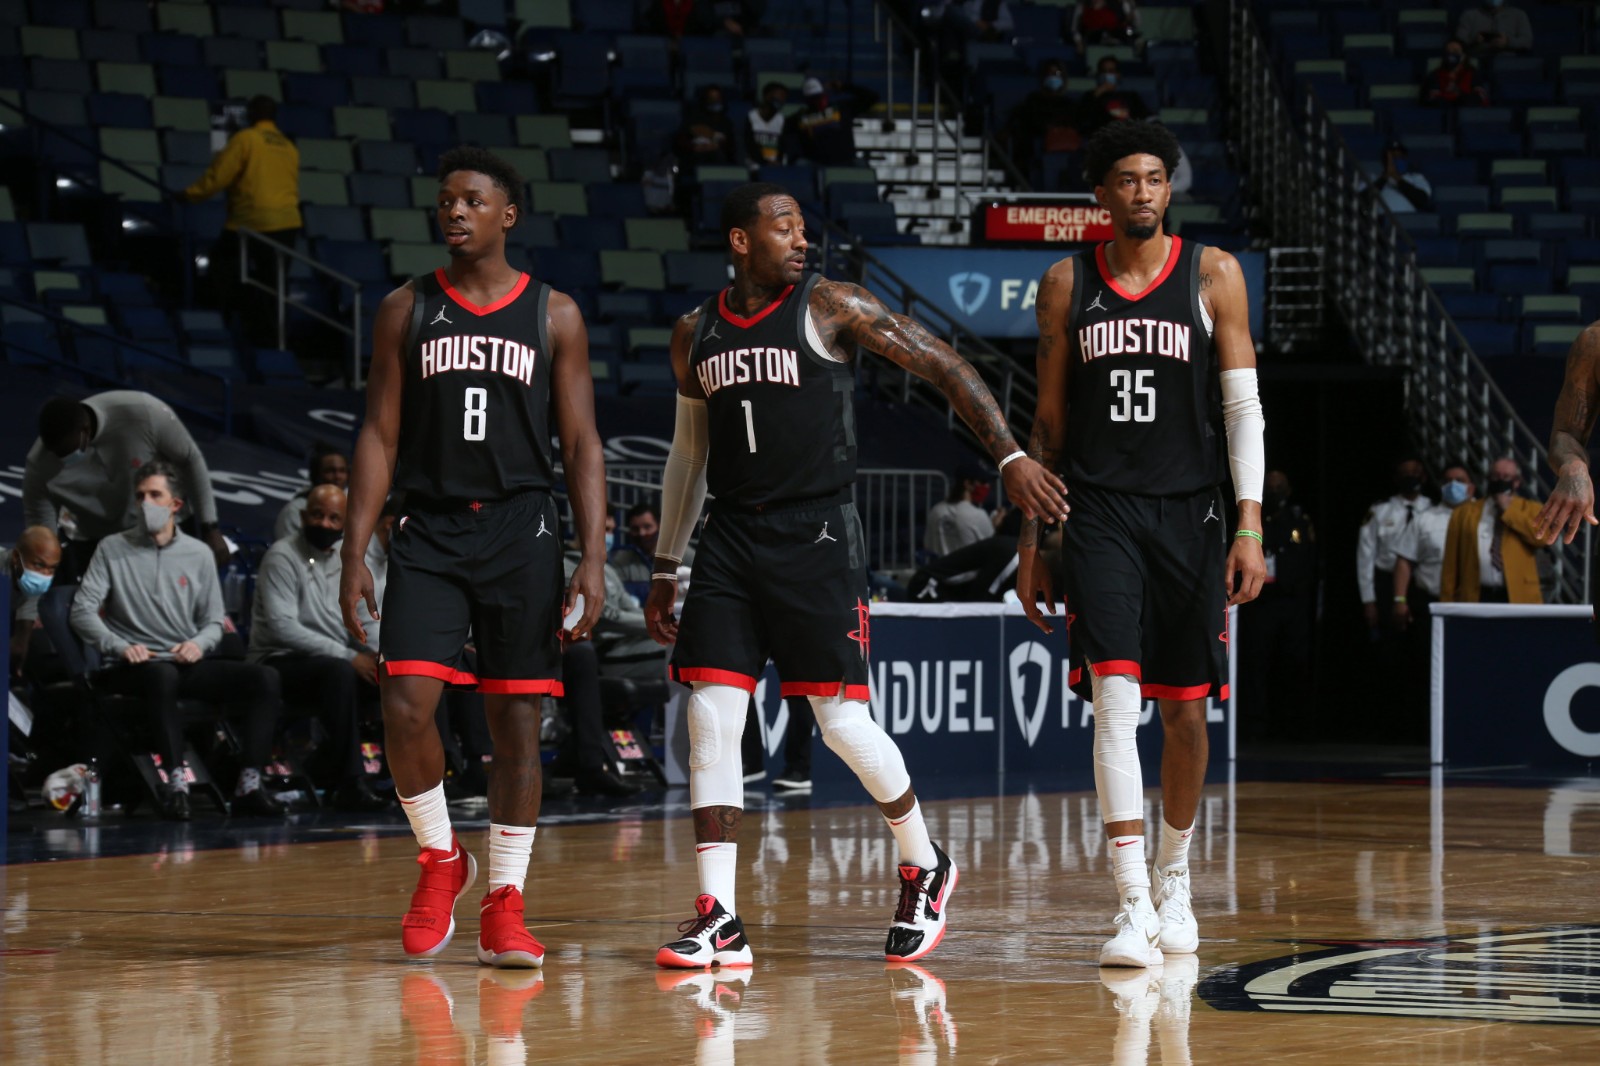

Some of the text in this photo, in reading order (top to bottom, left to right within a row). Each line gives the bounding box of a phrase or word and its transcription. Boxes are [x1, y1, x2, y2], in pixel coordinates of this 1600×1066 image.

[1006, 206, 1113, 225] EMERGENC
[1044, 224, 1086, 242] EXIT
[421, 335, 536, 387] HOUSTON
[1079, 318, 1190, 363] HOUSTON
[696, 347, 800, 399] HOUSTON
[1110, 369, 1156, 422] 35
[463, 387, 488, 442] 8
[741, 400, 757, 454] 1
[867, 659, 996, 736] NDUEL
